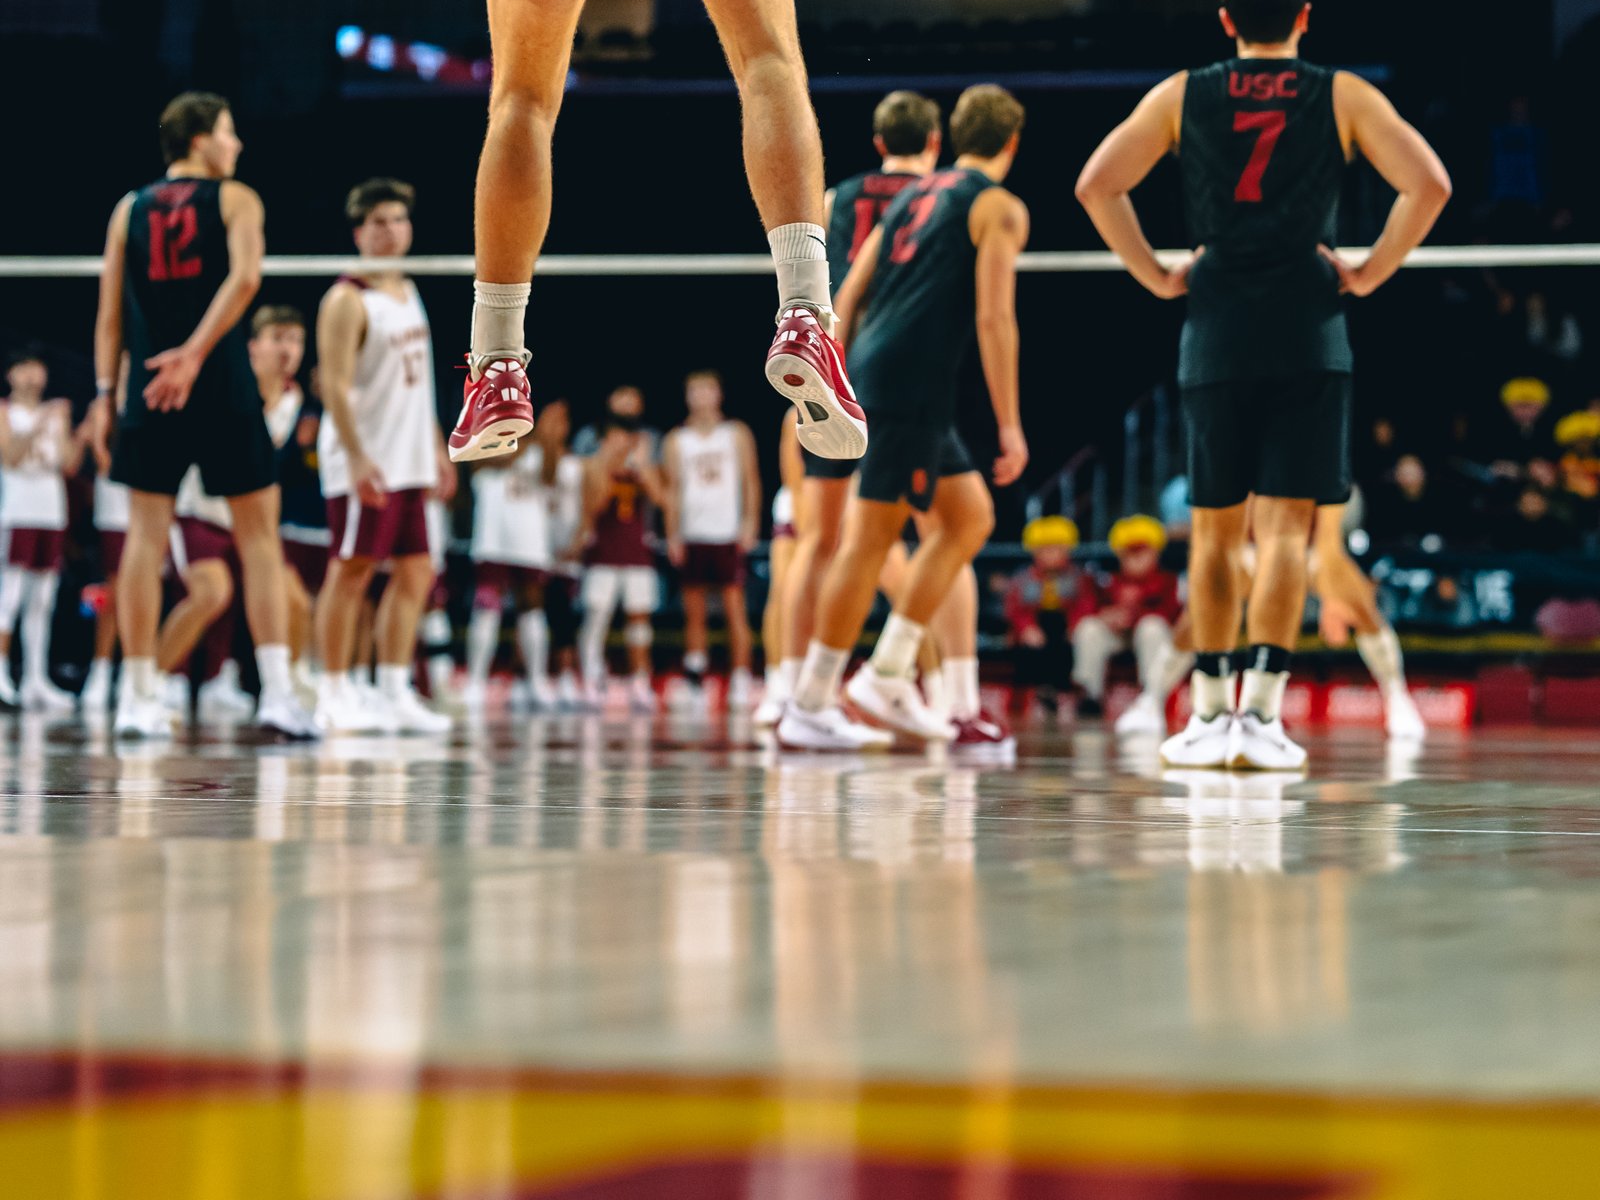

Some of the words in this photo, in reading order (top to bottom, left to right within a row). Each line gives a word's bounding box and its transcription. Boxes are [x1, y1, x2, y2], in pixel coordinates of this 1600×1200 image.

[1228, 71, 1298, 100] USC
[1233, 111, 1287, 202] 7
[147, 204, 202, 281] 12
